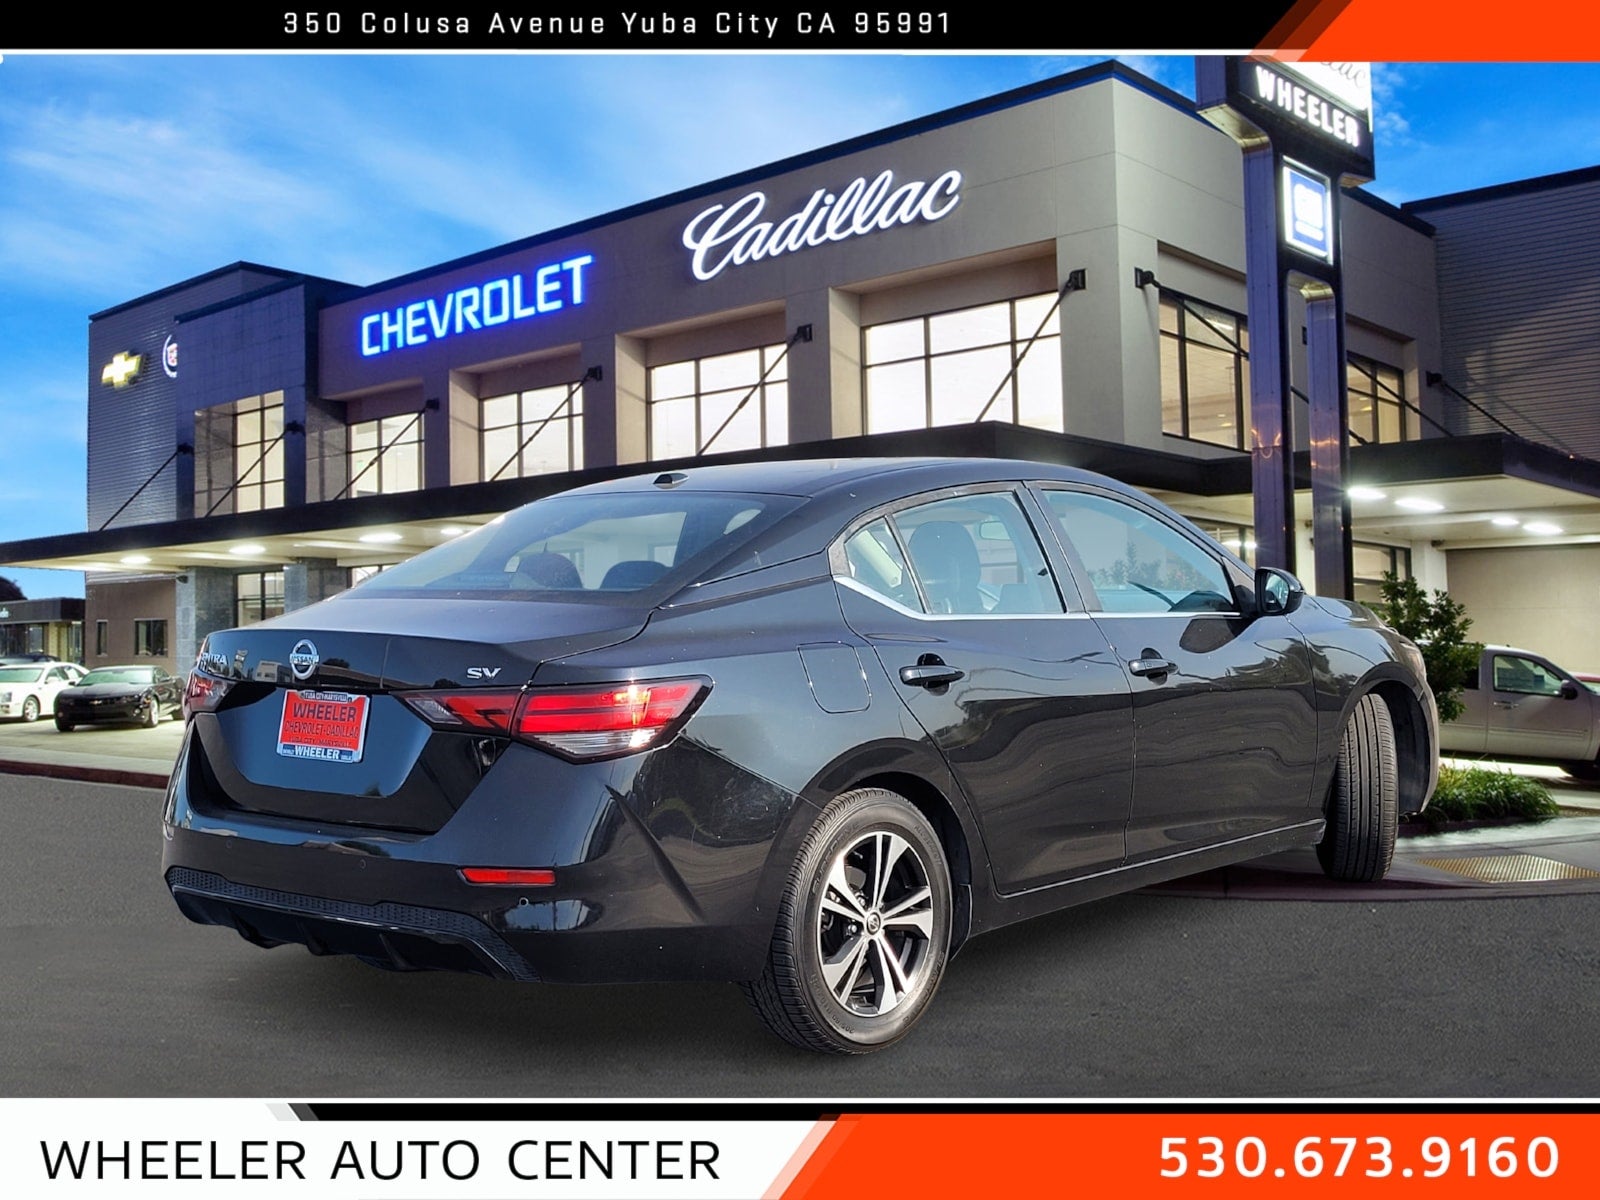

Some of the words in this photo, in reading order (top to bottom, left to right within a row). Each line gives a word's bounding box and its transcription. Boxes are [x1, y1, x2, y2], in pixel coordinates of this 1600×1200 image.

[1256, 65, 1360, 147] WHEELER
[682, 169, 963, 281] Cadillac
[360, 255, 593, 357] CHEVROLET
[466, 667, 502, 679] SV
[293, 702, 357, 722] WHEELER
[295, 745, 340, 760] WHEELER
